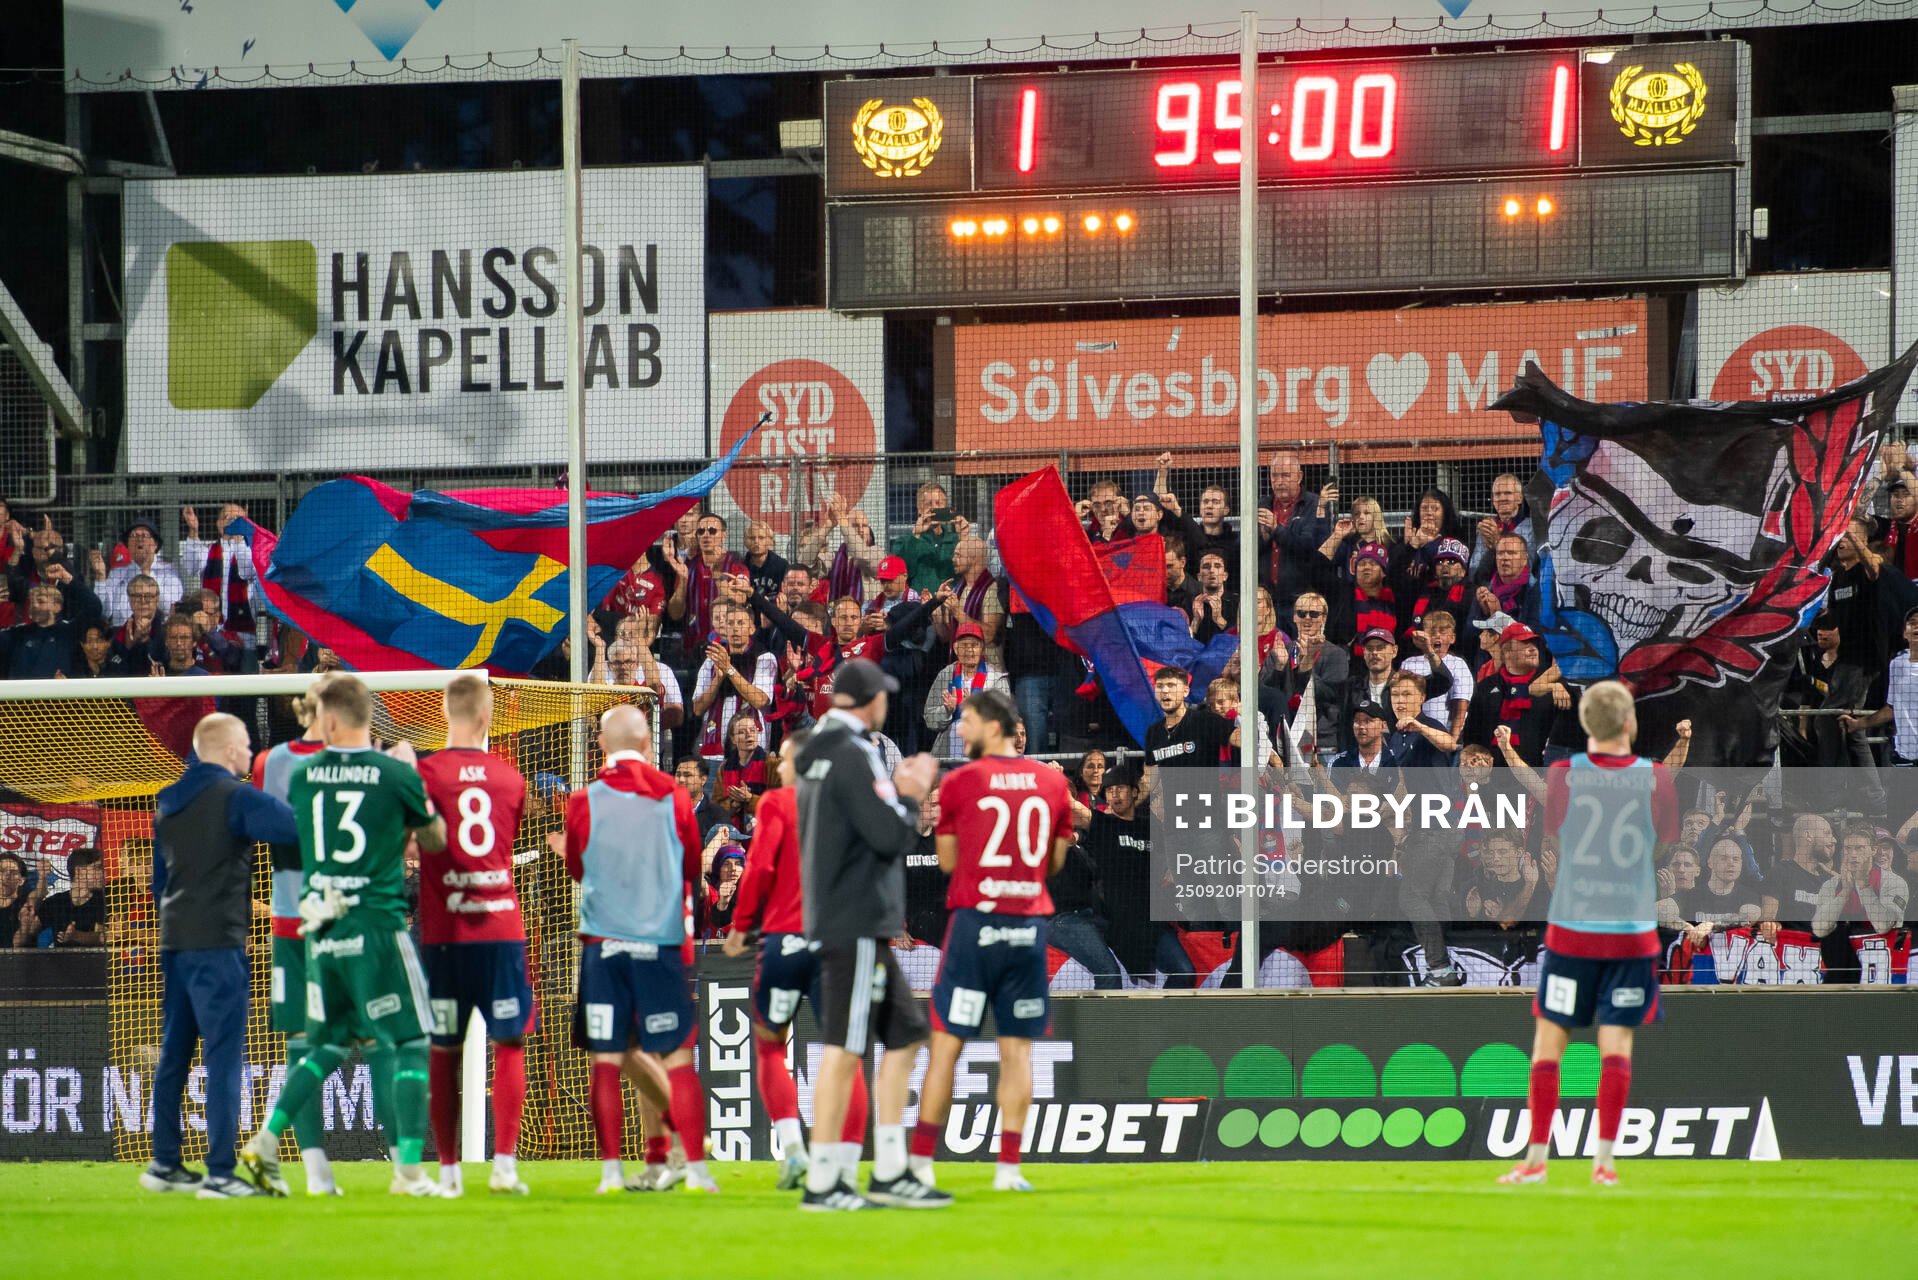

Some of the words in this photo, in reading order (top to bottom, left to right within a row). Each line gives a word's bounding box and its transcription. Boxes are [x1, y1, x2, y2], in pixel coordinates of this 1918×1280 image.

[1018, 88, 1037, 173] 1
[1154, 73, 1396, 168] 95:00
[1549, 65, 1569, 152] 1
[331, 243, 659, 322] HANSSON
[333, 325, 564, 395] KAPELL
[583, 322, 663, 390] AB
[979, 354, 1350, 428] Sölvesborg
[1750, 349, 1835, 395] SYD
[758, 381, 835, 427] SYD
[306, 765, 381, 784] WALLINDER
[458, 764, 488, 782] ASK
[311, 789, 367, 864] 13
[457, 786, 496, 858] 8
[976, 795, 1051, 868] 20
[1570, 794, 1645, 869] 26
[1, 1048, 84, 1134] ÖR
[103, 1064, 292, 1133] NST
[709, 982, 752, 1161] SELECT
[944, 1103, 1198, 1154] UNIBET
[1486, 1106, 1750, 1158] UNIBET
